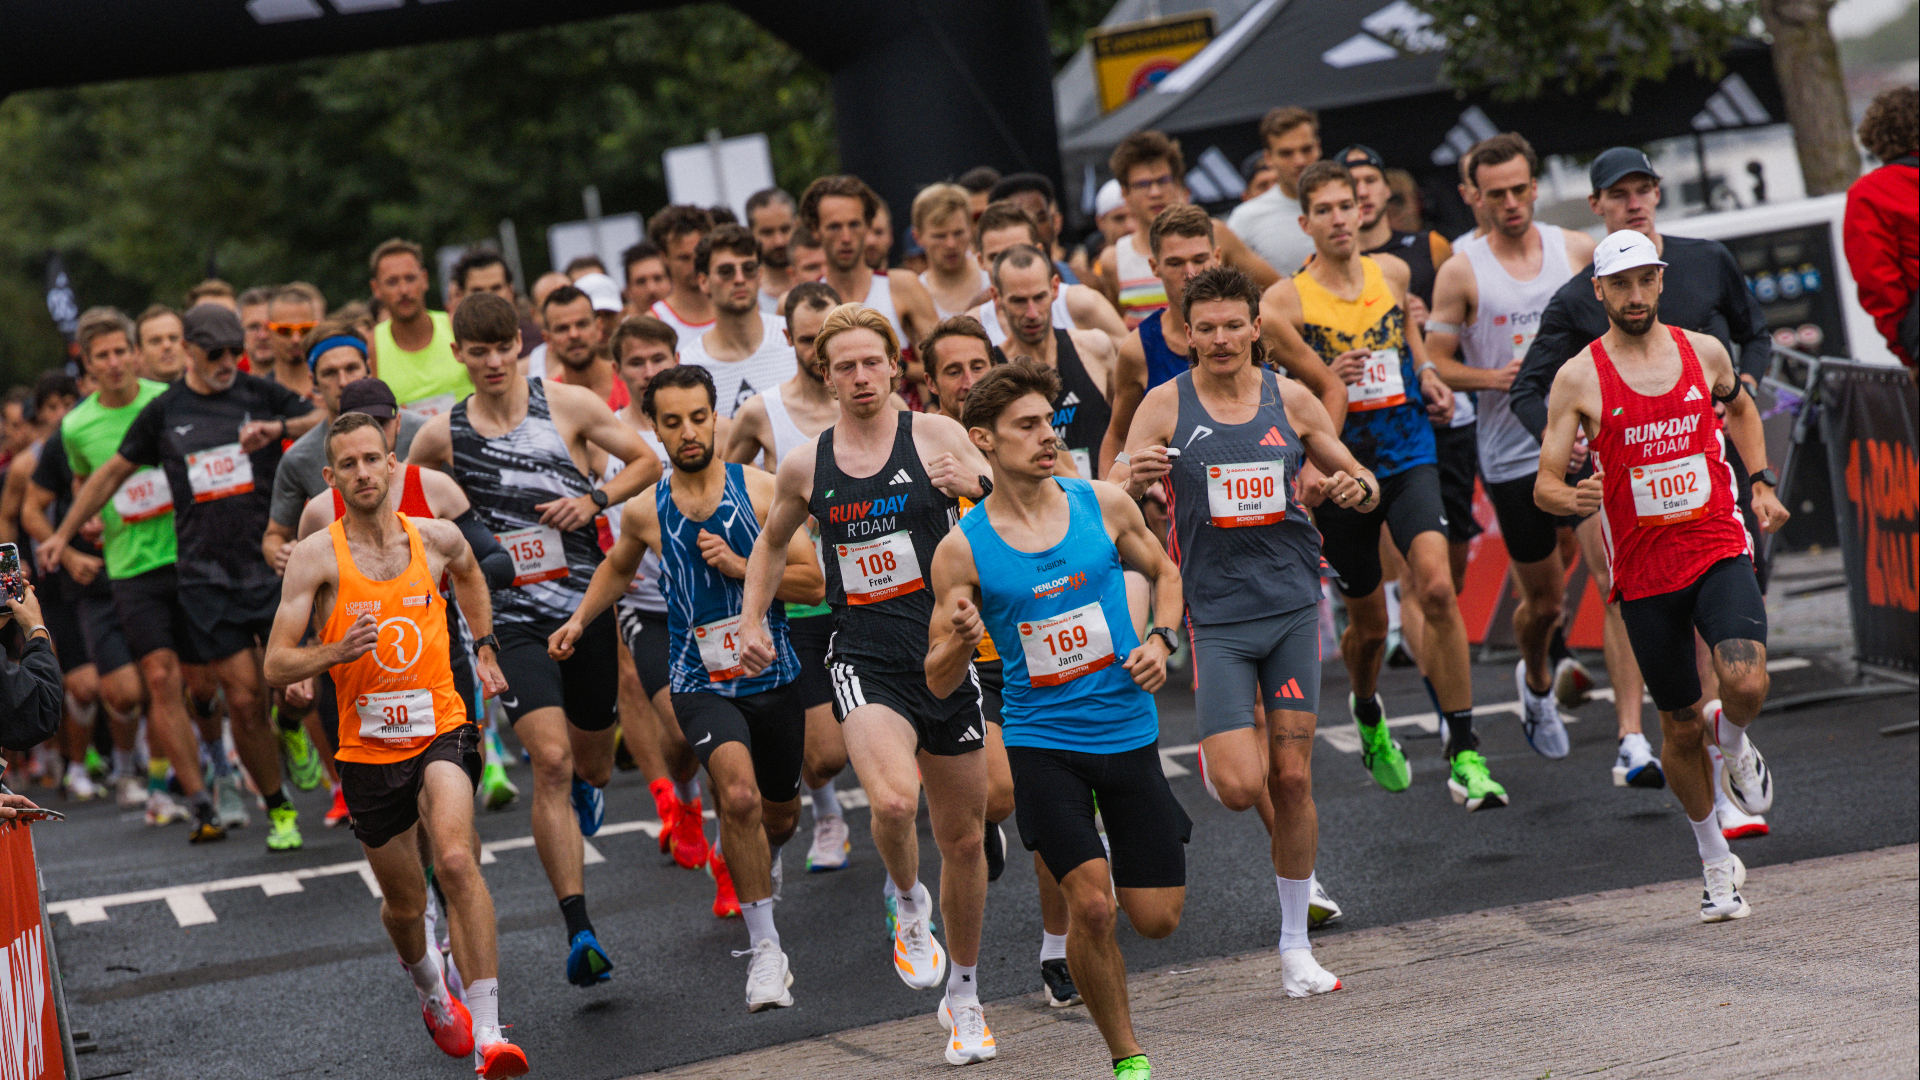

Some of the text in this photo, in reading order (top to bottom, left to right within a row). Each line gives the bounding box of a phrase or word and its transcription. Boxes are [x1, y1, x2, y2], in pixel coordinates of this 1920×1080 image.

[1222, 476, 1274, 500] 1090
[1646, 471, 1698, 500] 1002
[1238, 501, 1262, 511] Emiel
[1663, 498, 1688, 510] Edwin
[1663, 511, 1692, 520] SCHOUTEN
[509, 539, 545, 562] 153
[855, 550, 897, 577] 108
[1037, 558, 1066, 573] FUSION
[869, 575, 893, 587] Freek
[1032, 576, 1070, 594] VENLOOP
[869, 586, 898, 598] SCHOUTEN
[1035, 585, 1064, 599] Running
[345, 600, 373, 610] LOPERS
[1043, 625, 1088, 656] 169
[1058, 653, 1083, 667] Jarno
[1058, 665, 1089, 678] SCHOUTEN
[382, 704, 408, 726] 30
[381, 724, 413, 734] Reinout
